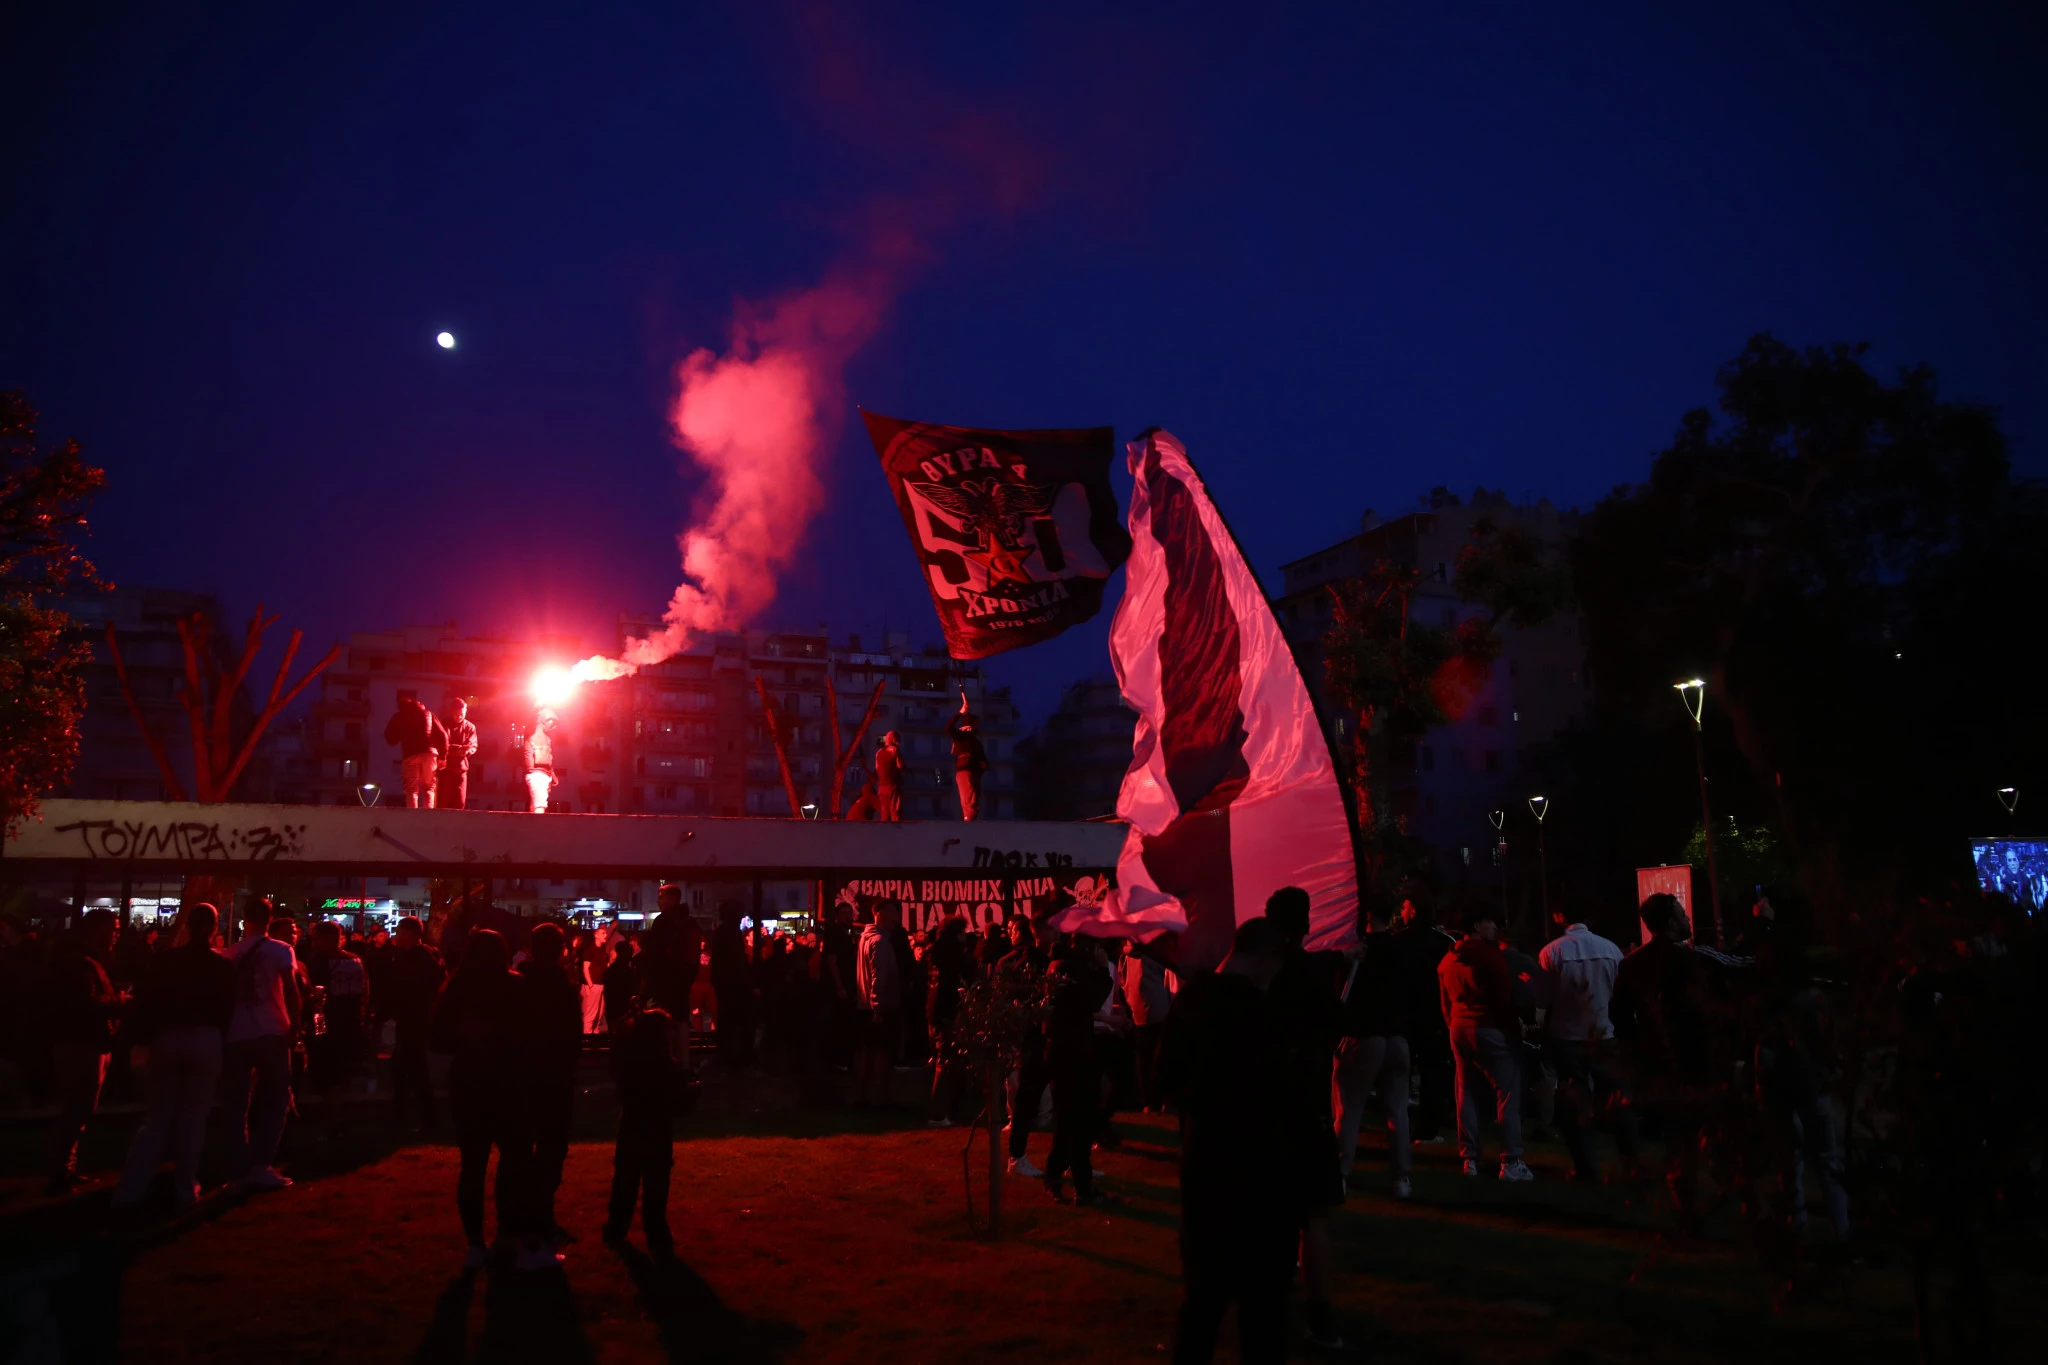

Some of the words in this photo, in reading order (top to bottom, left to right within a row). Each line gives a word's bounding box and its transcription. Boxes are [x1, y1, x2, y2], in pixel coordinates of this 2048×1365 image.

[920, 447, 1002, 482] ΘΥΡΑ
[959, 581, 1070, 618] ΧΡΟΝΙΑ
[861, 879, 915, 902] ΒΑΡΙΑ
